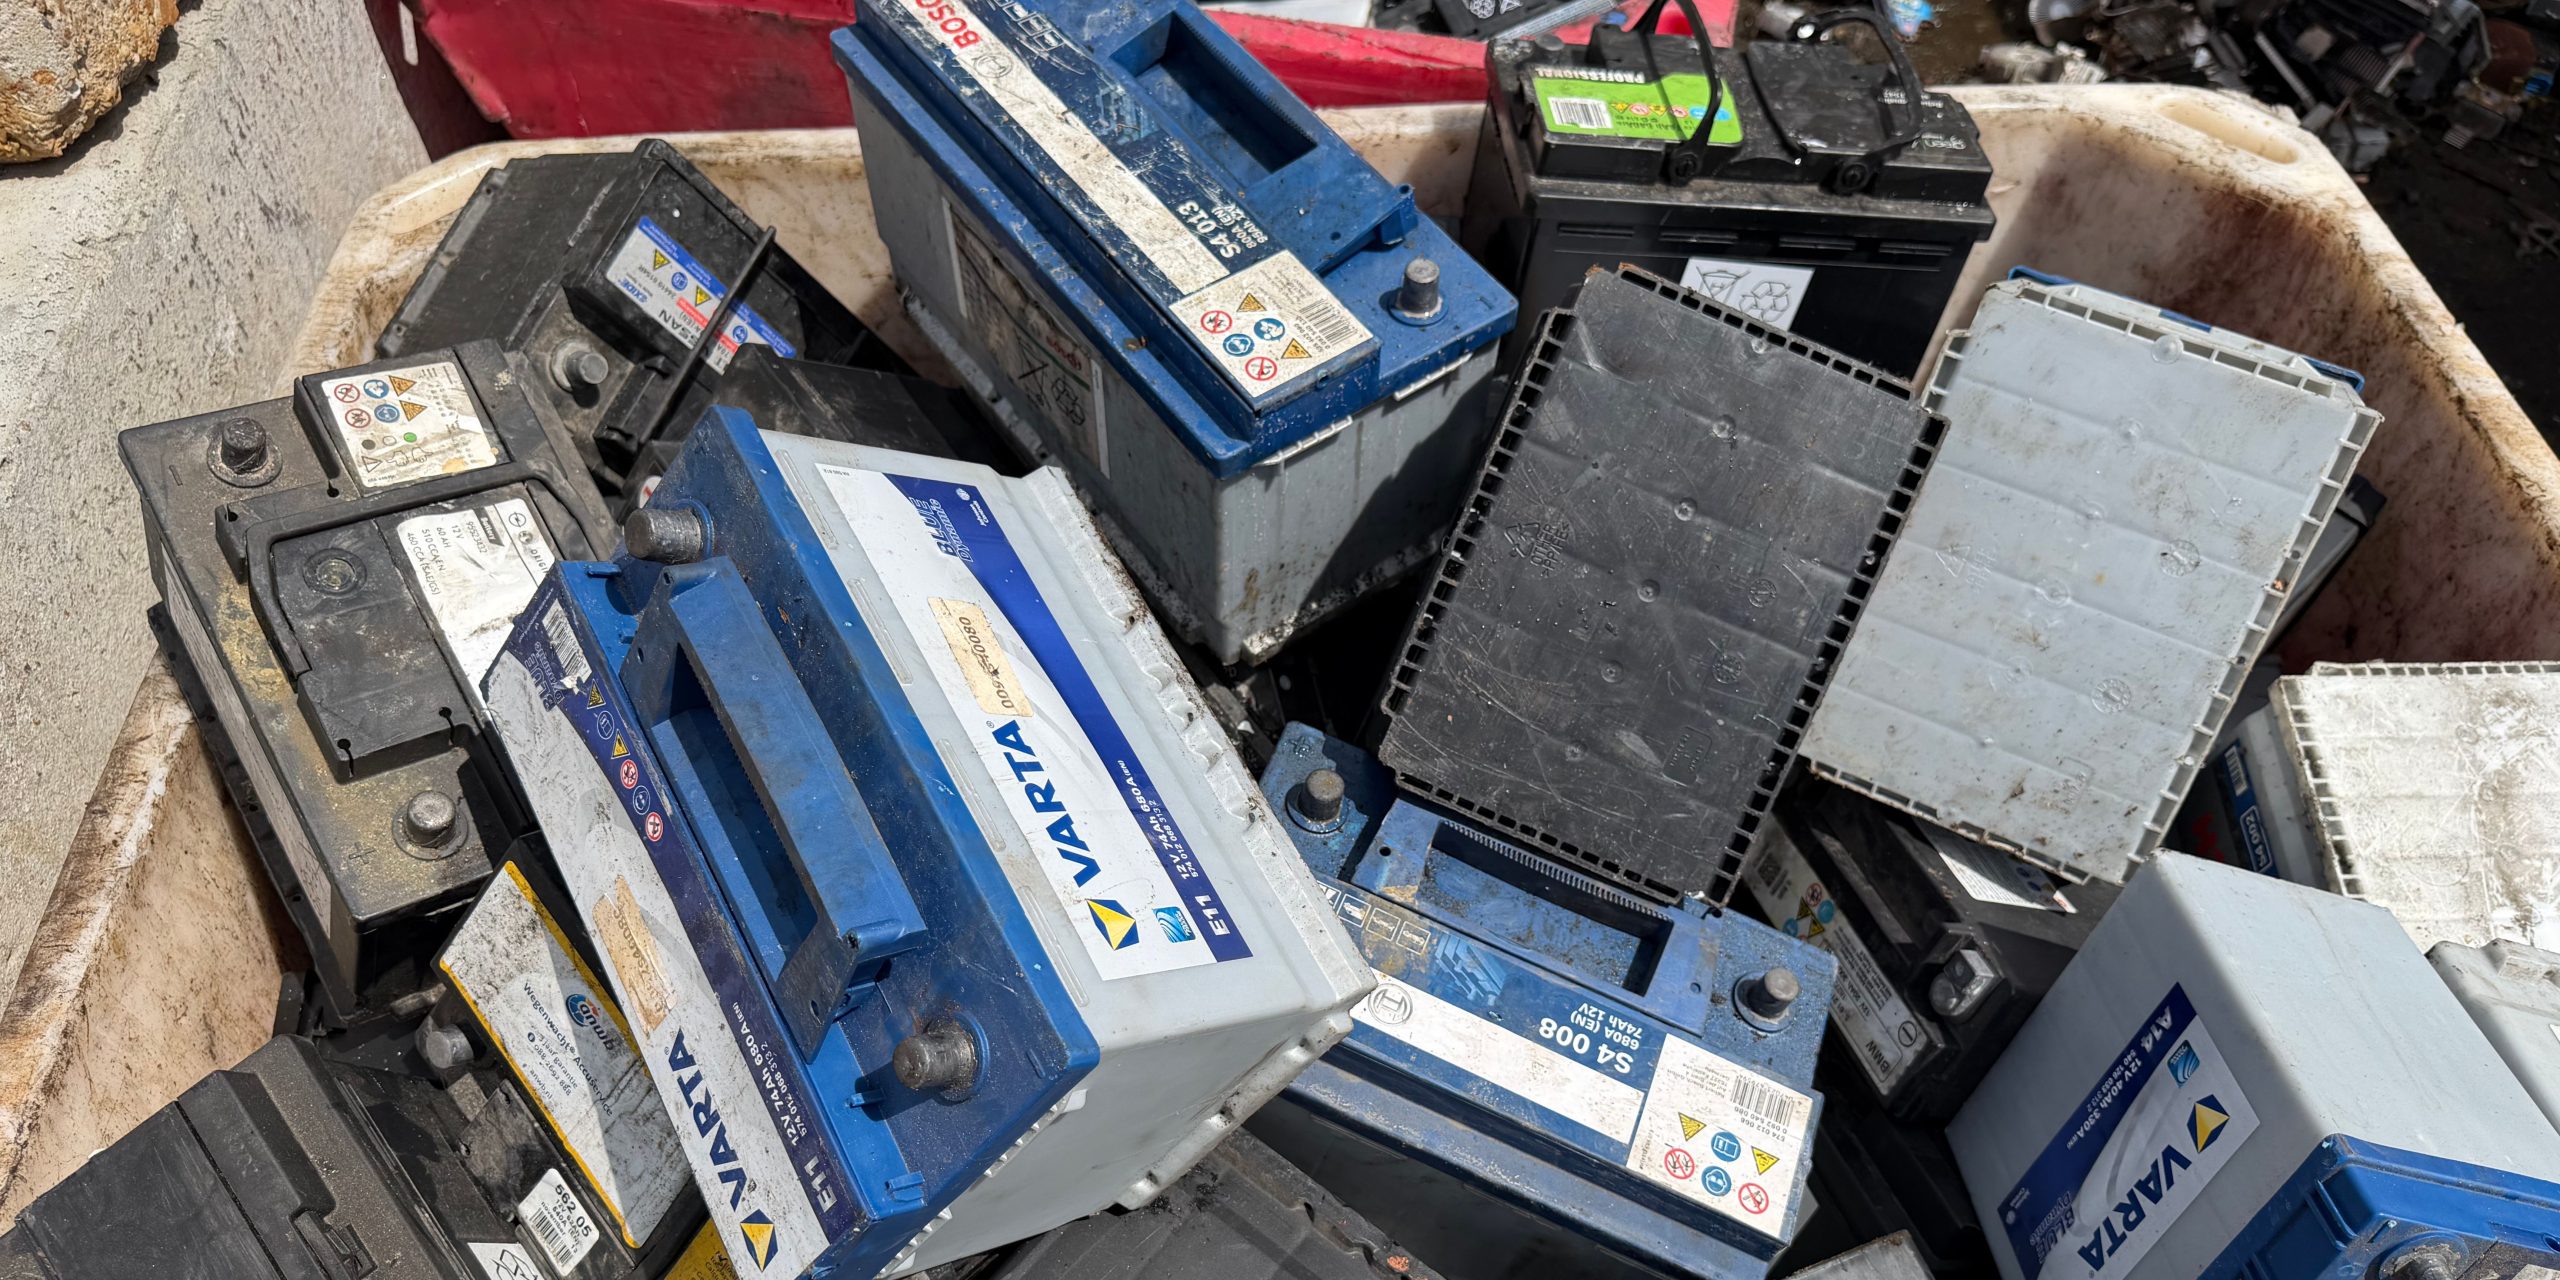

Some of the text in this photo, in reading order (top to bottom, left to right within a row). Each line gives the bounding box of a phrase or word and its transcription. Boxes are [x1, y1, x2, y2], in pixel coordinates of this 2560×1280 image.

[1535, 68, 1644, 82] PROFESSIONAL
[1176, 197, 1242, 260] S4 013
[1209, 205, 1257, 250] 800A (EN)
[1242, 220, 1269, 244] 95Ah
[908, 496, 956, 553] BLUE
[927, 497, 974, 561] Dynamic
[523, 652, 557, 712] BLUE
[990, 716, 1097, 888] VARTA
[1146, 815, 1174, 849] 74Ah
[2244, 813, 2260, 843] 002
[1167, 852, 1193, 879] 12V
[1194, 893, 1231, 936] E11
[577, 1001, 618, 1052] anwb
[1568, 1009, 1640, 1051] 680A (EN)
[1578, 1001, 1643, 1039] 74Ah 12V
[2139, 1005, 2172, 1054] A14
[758, 1040, 769, 1050] 2
[763, 1049, 779, 1072] 313
[1535, 1014, 1635, 1075] S4 008
[1864, 1039, 1891, 1073] BMW
[528, 1067, 554, 1100] anwb.nl
[551, 1054, 580, 1090] garantie
[557, 1078, 573, 1096] 888
[571, 1055, 615, 1117] Accuservice
[759, 1064, 786, 1110] 74Ah
[772, 1070, 789, 1094] 068
[2122, 1056, 2141, 1081] 12V
[2098, 1078, 2123, 1110] 40Ah
[664, 1026, 748, 1210] VARTA
[780, 1113, 802, 1146] 12V
[793, 1114, 809, 1136] 574
[803, 1154, 838, 1212] E11
[540, 1201, 566, 1235] november
[552, 1205, 568, 1226] 540A
[554, 1183, 592, 1237] 562 05
[555, 1198, 566, 1212] 12V
[2076, 1144, 2192, 1271] VARTA
[2034, 1205, 2077, 1259] BLUE
